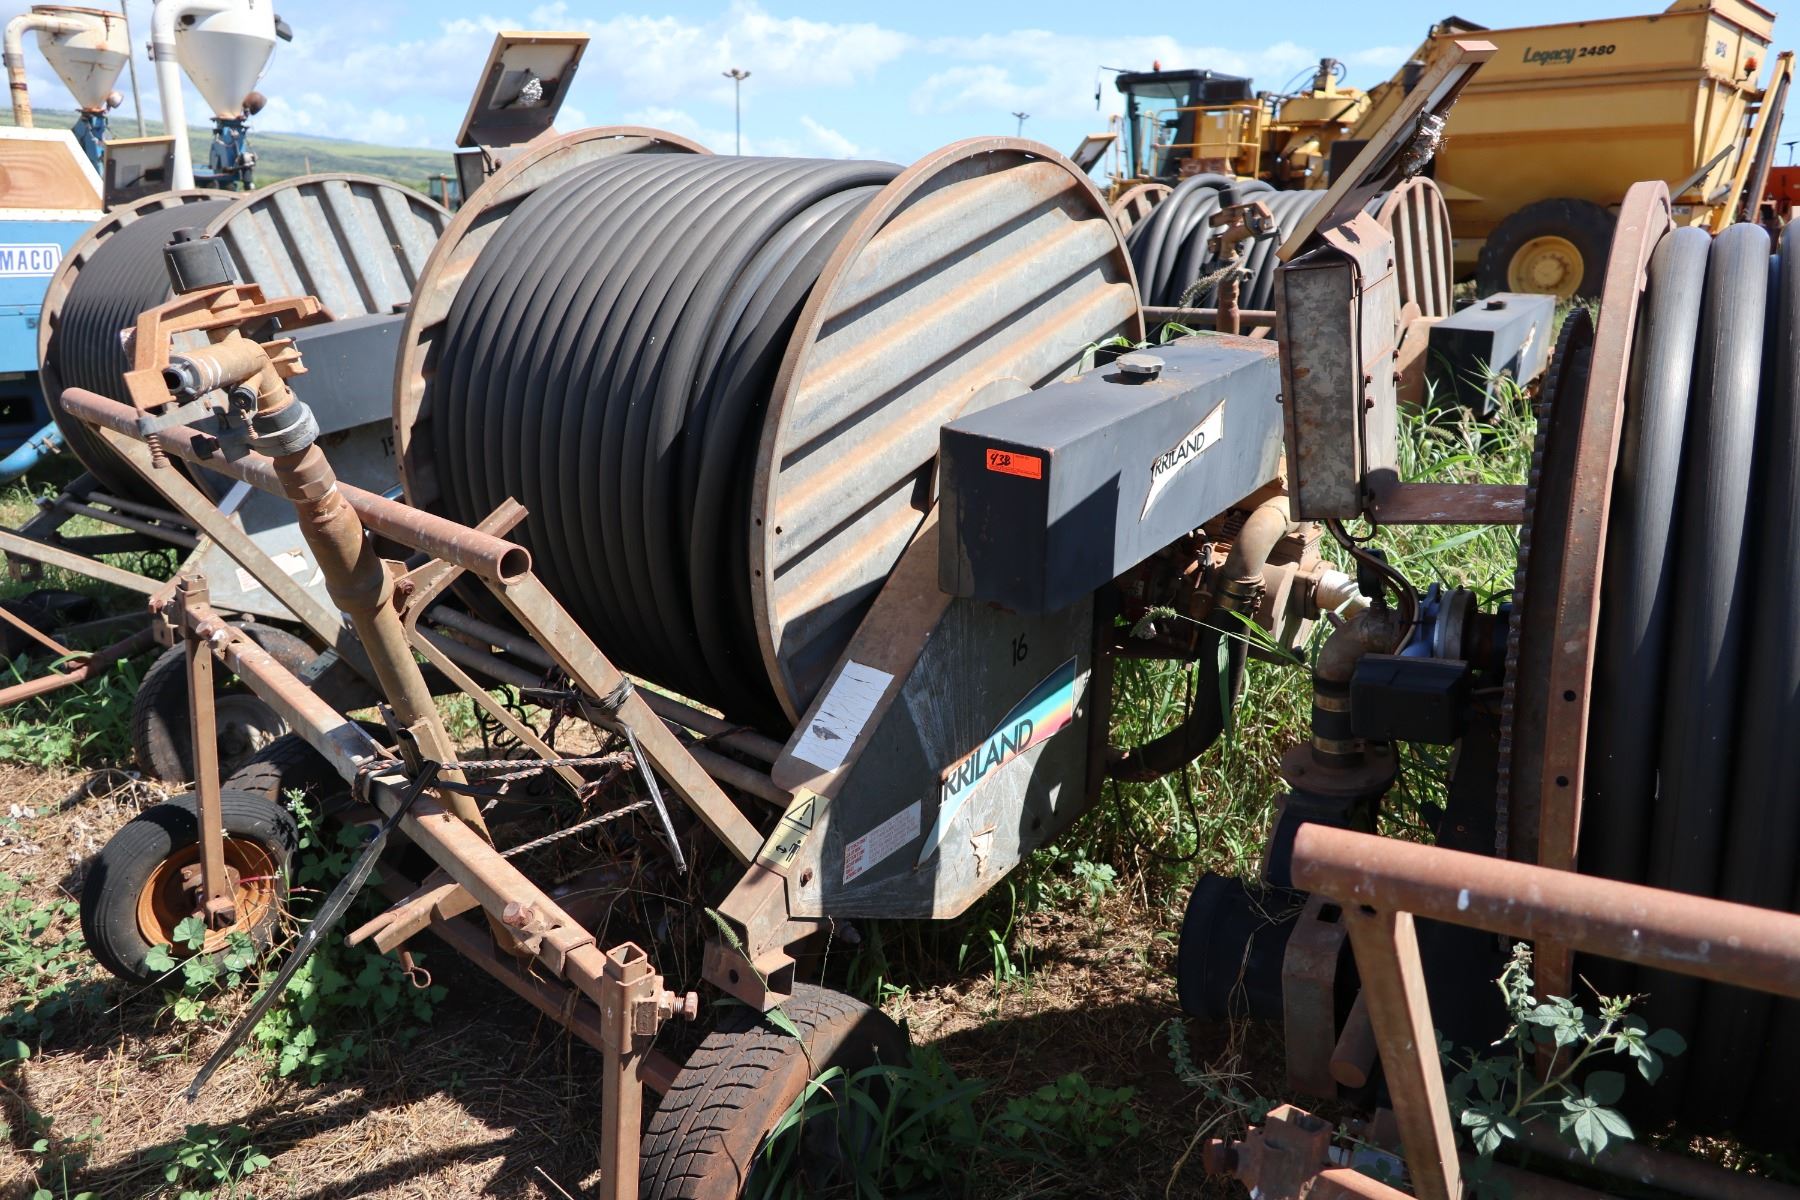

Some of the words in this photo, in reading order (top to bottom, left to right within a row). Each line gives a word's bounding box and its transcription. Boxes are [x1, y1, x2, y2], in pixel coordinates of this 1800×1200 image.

[1522, 46, 1576, 66] Legacy
[1579, 44, 1616, 57] 2480
[1011, 632, 1029, 667] 16
